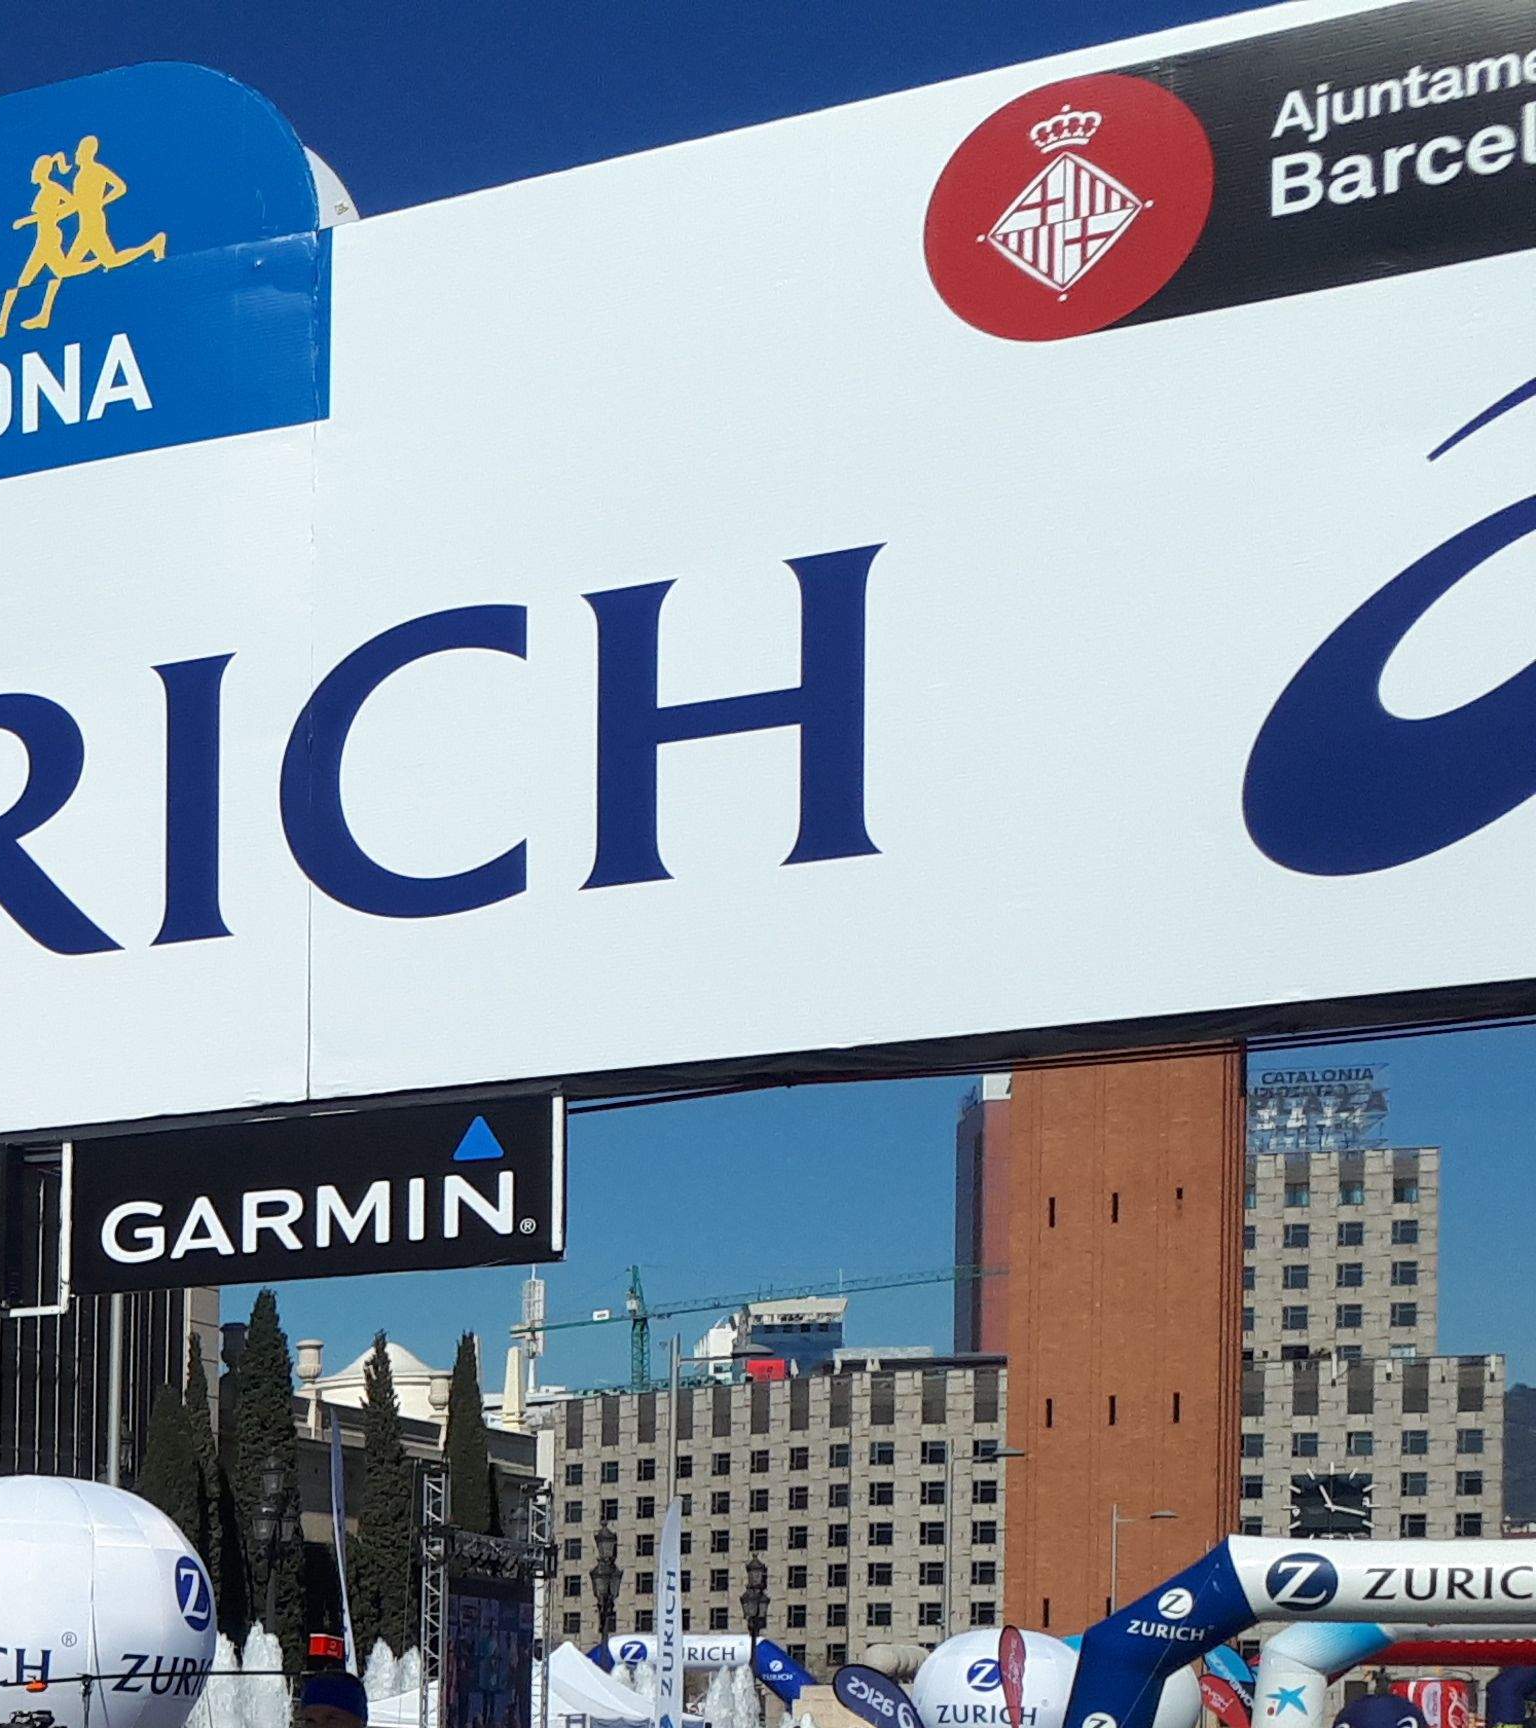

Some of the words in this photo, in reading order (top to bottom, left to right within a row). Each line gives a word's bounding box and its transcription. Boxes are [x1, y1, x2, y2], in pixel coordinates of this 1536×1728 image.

[1261, 1067, 1374, 1085] CATALONIA
[100, 1169, 517, 1265] GARMIN
[1362, 1566, 1534, 1602] ZURIC
[660, 1570, 677, 1697] ZURICH
[1126, 1619, 1205, 1642] ZURICH
[936, 1703, 1038, 1726] ZURICH
